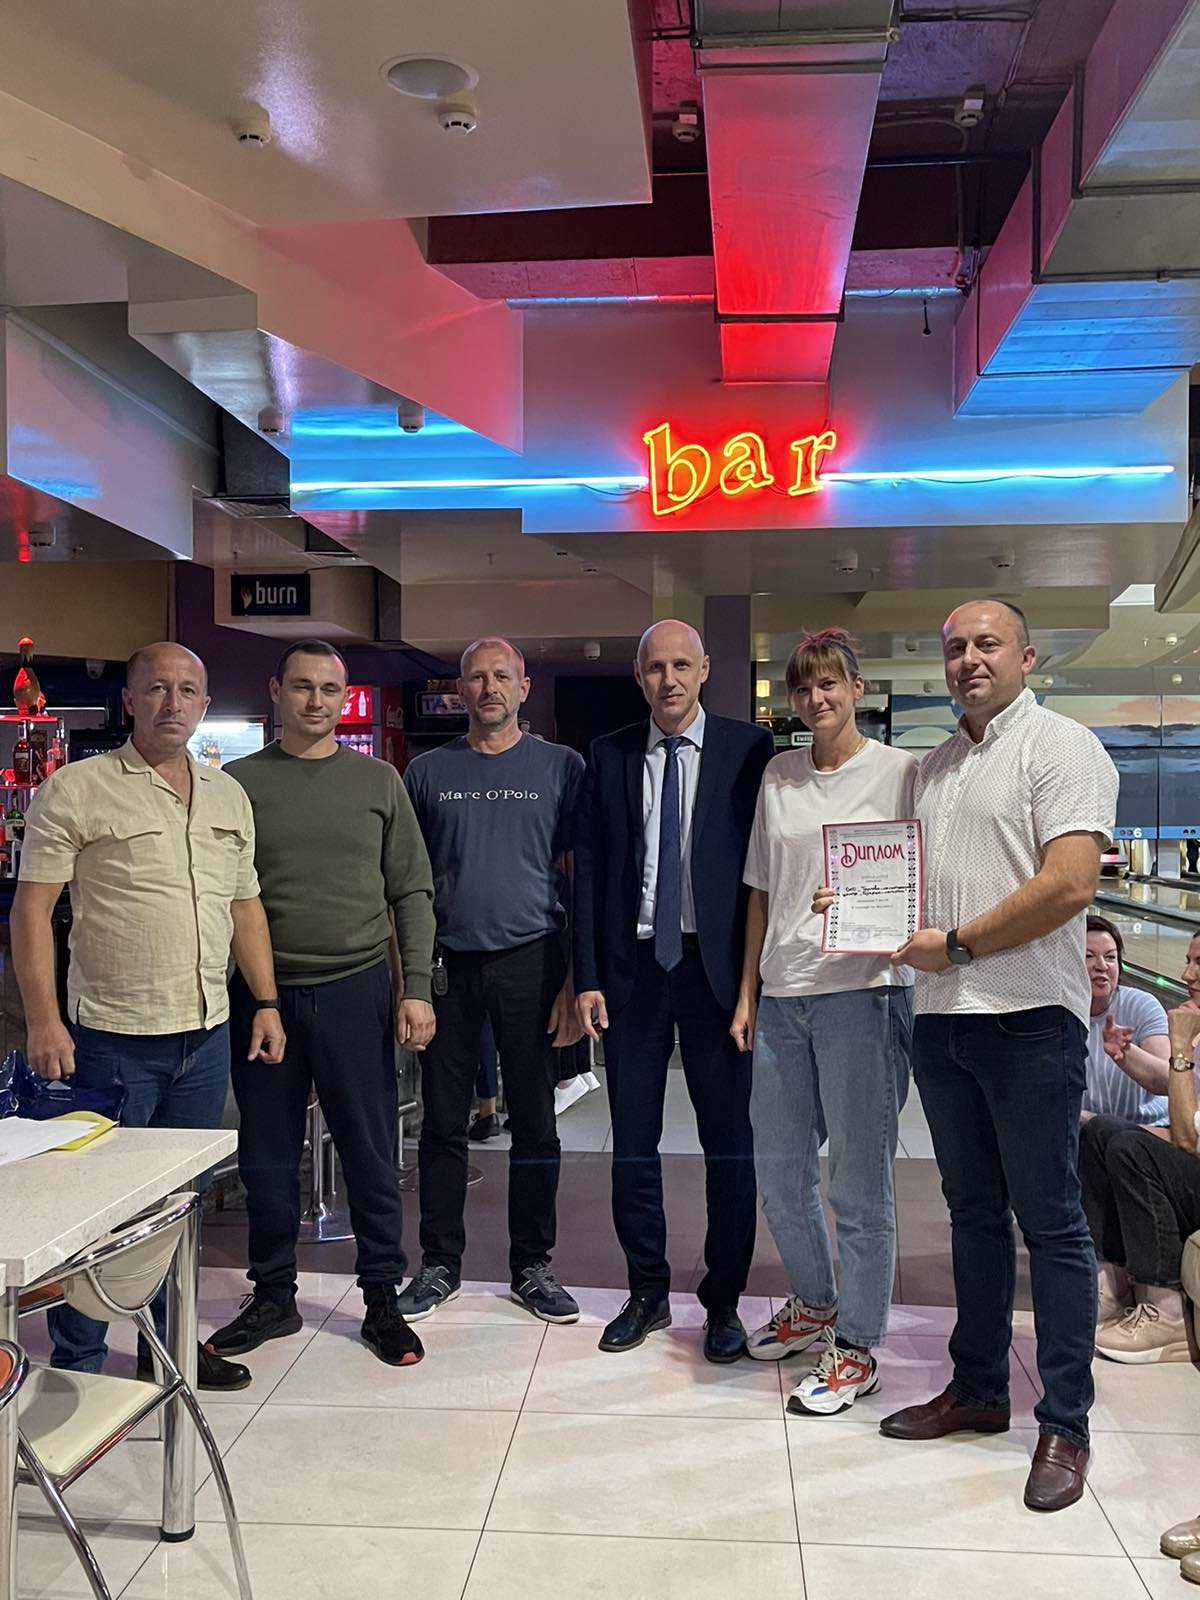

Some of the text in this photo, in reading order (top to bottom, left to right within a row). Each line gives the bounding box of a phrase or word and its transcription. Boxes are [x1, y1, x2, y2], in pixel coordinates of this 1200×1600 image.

[642, 422, 837, 516] bar
[256, 580, 297, 604] burn
[438, 788, 539, 802] Marc O'Polo
[1133, 827, 1143, 838] 6
